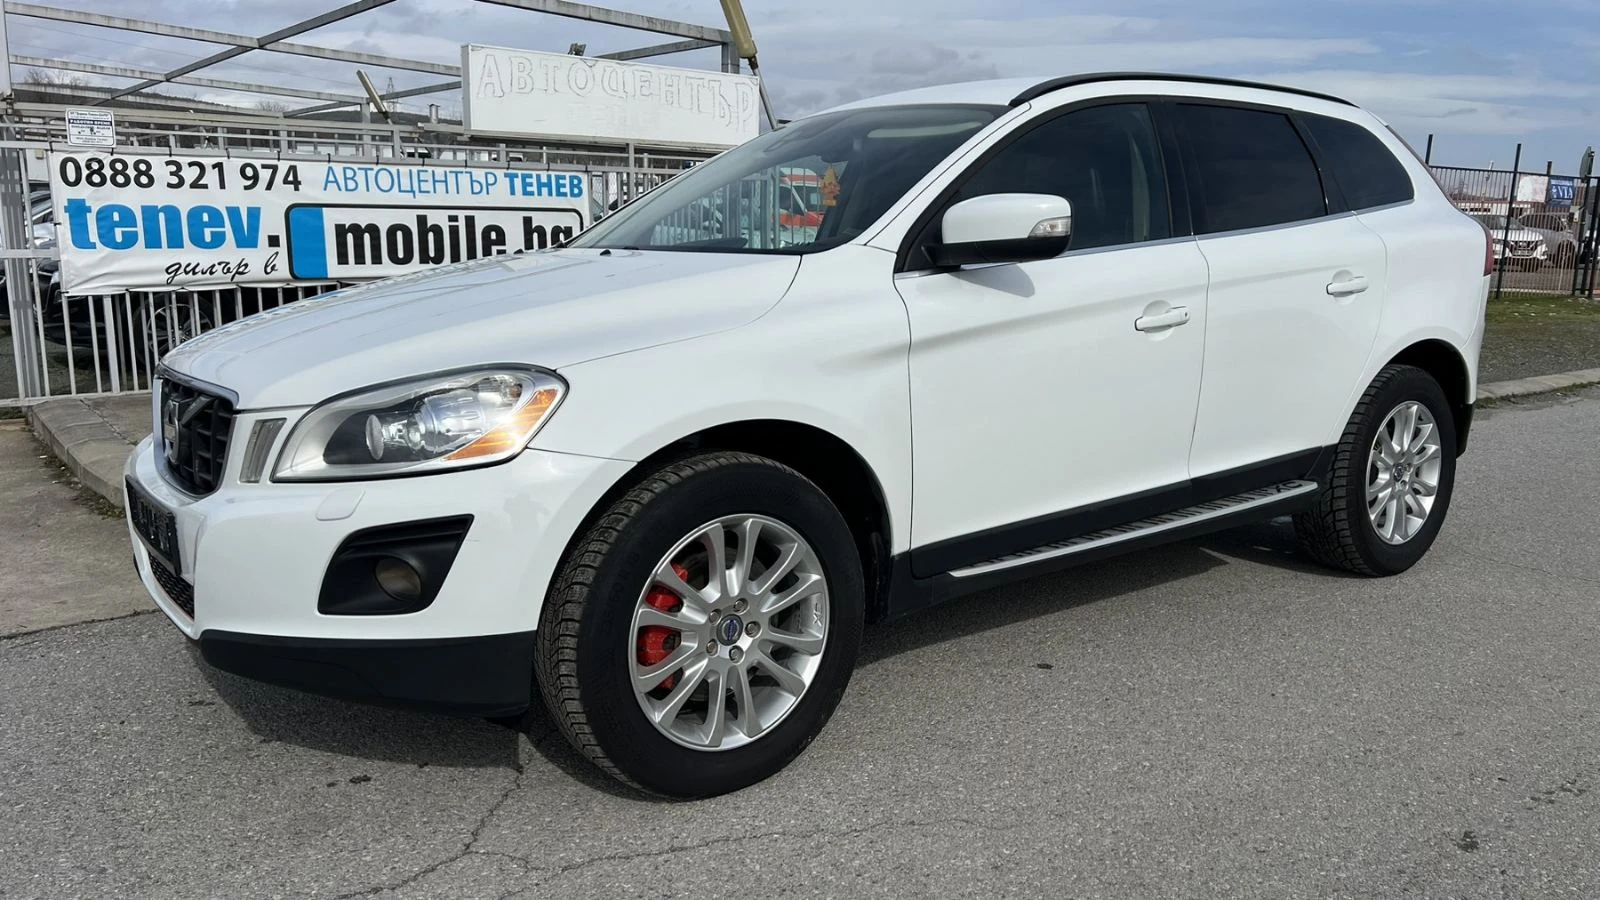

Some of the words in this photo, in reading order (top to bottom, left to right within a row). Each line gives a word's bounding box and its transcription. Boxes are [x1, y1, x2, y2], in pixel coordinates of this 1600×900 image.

[477, 54, 756, 131] АВТОЦЕНТЪР
[59, 156, 155, 189] 0888
[164, 160, 227, 190] 321
[239, 163, 302, 192] 974
[323, 166, 498, 199] АВТОЦЕНТЪР
[504, 172, 583, 198] ТЕНЕВ
[334, 214, 574, 266] mobileb
[165, 258, 251, 284] дилър
[263, 251, 280, 275] в
